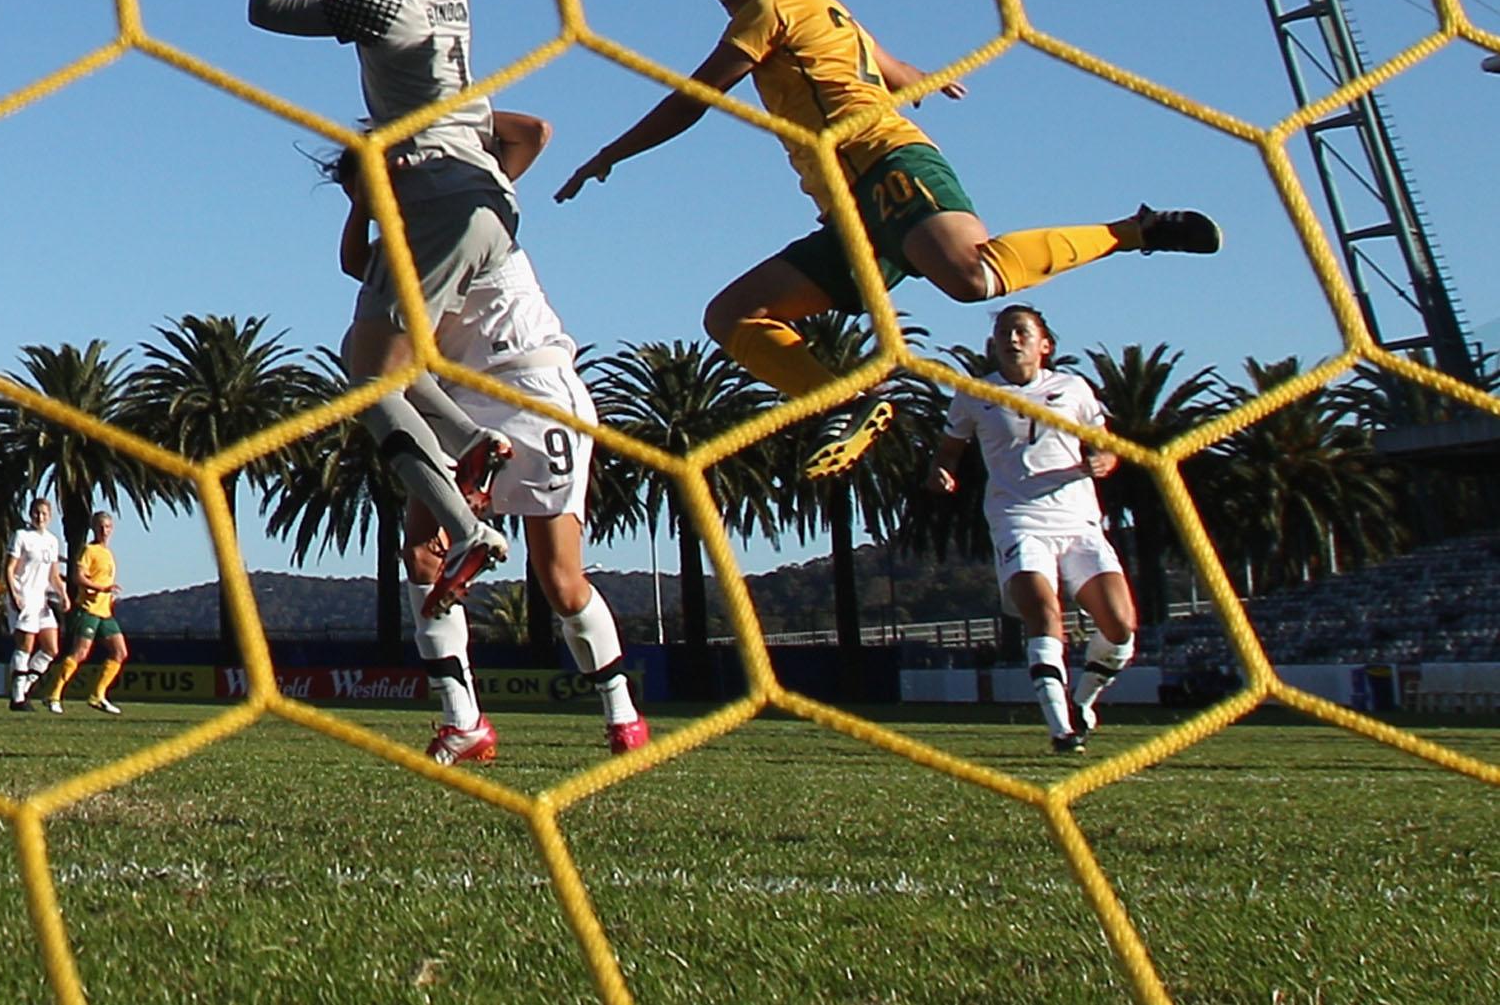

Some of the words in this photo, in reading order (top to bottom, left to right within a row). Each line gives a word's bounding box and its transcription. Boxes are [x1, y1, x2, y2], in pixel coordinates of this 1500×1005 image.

[871, 169, 915, 220] 20
[544, 428, 574, 476] 9
[118, 670, 195, 692] PTUS
[329, 669, 420, 697] Westfield
[506, 677, 539, 693] ON
